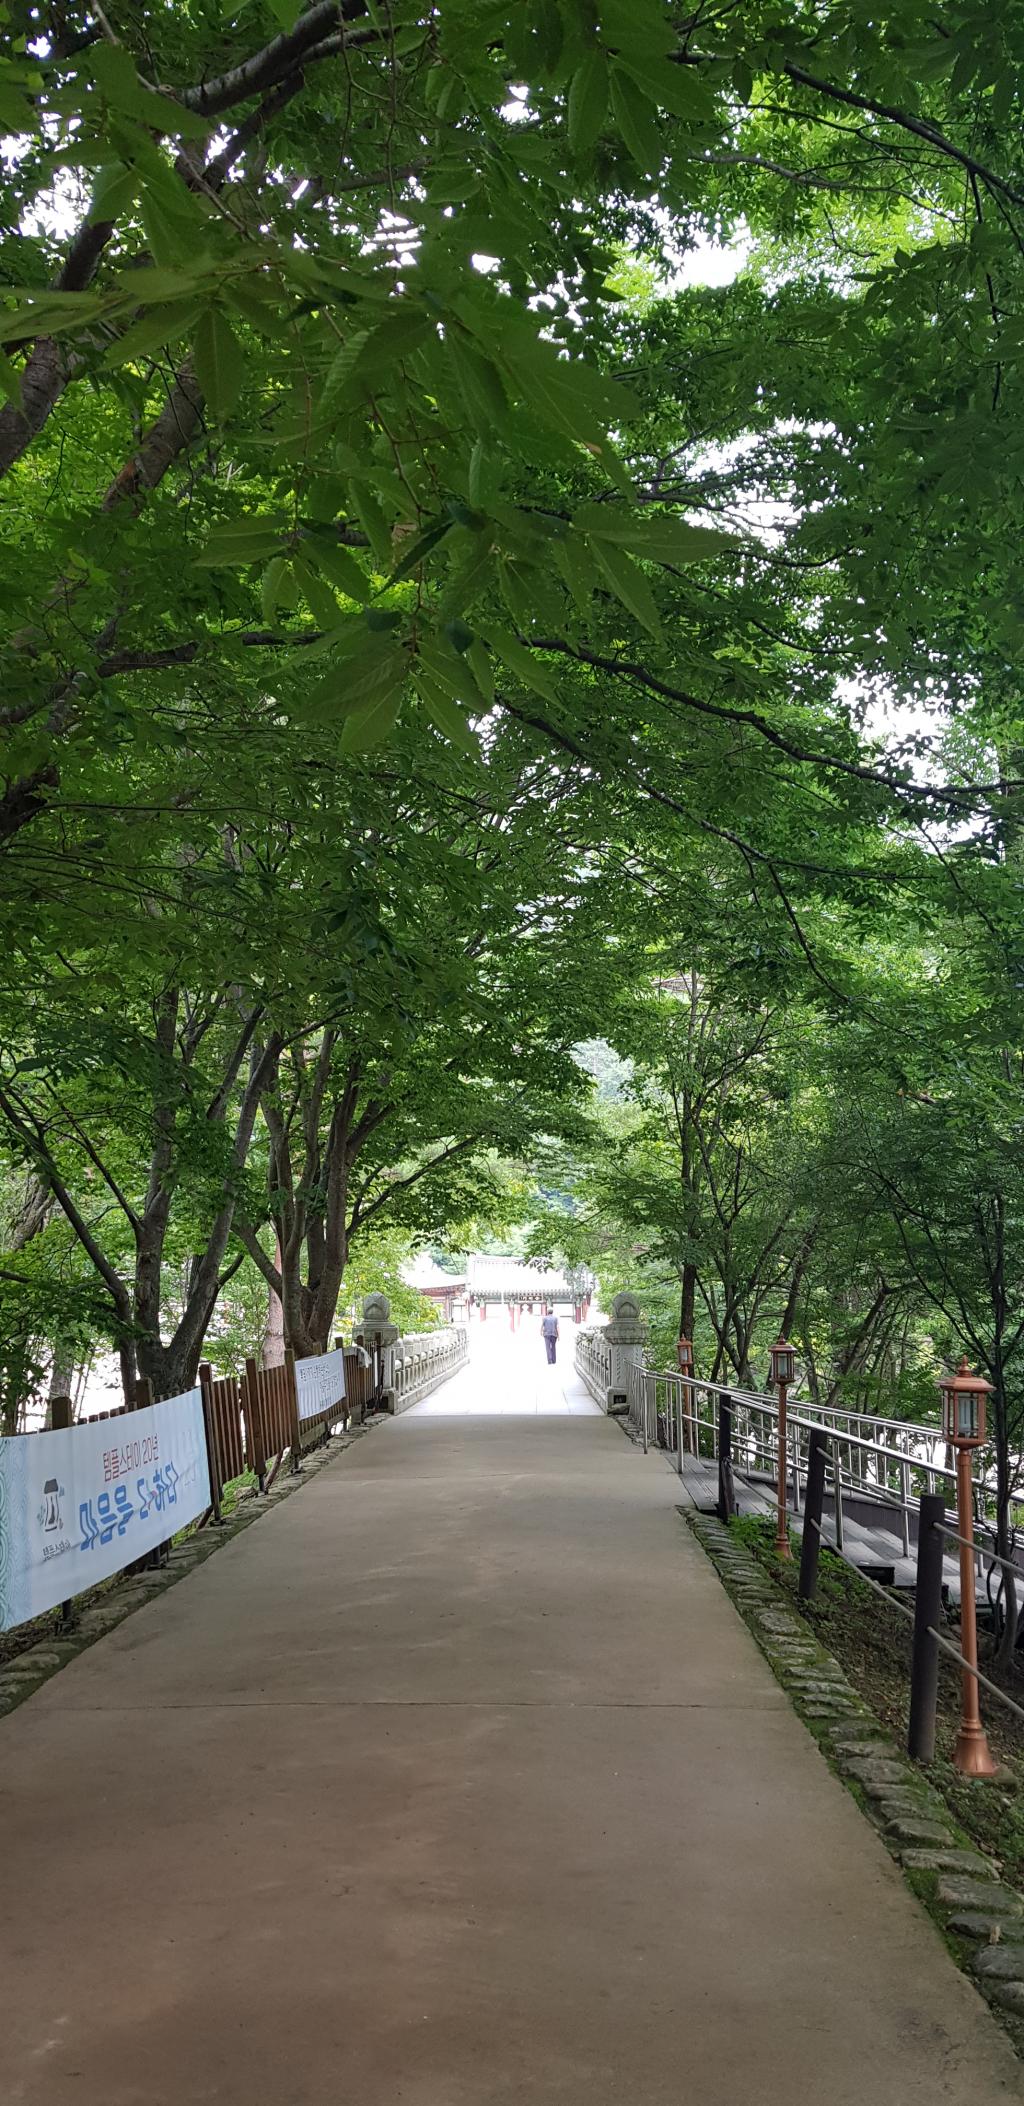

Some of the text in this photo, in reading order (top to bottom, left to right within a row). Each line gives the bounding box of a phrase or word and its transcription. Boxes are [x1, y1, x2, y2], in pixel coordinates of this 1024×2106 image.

[103, 1434, 159, 1482] 템플스테이 20년
[79, 1485, 134, 1551] 마음을
